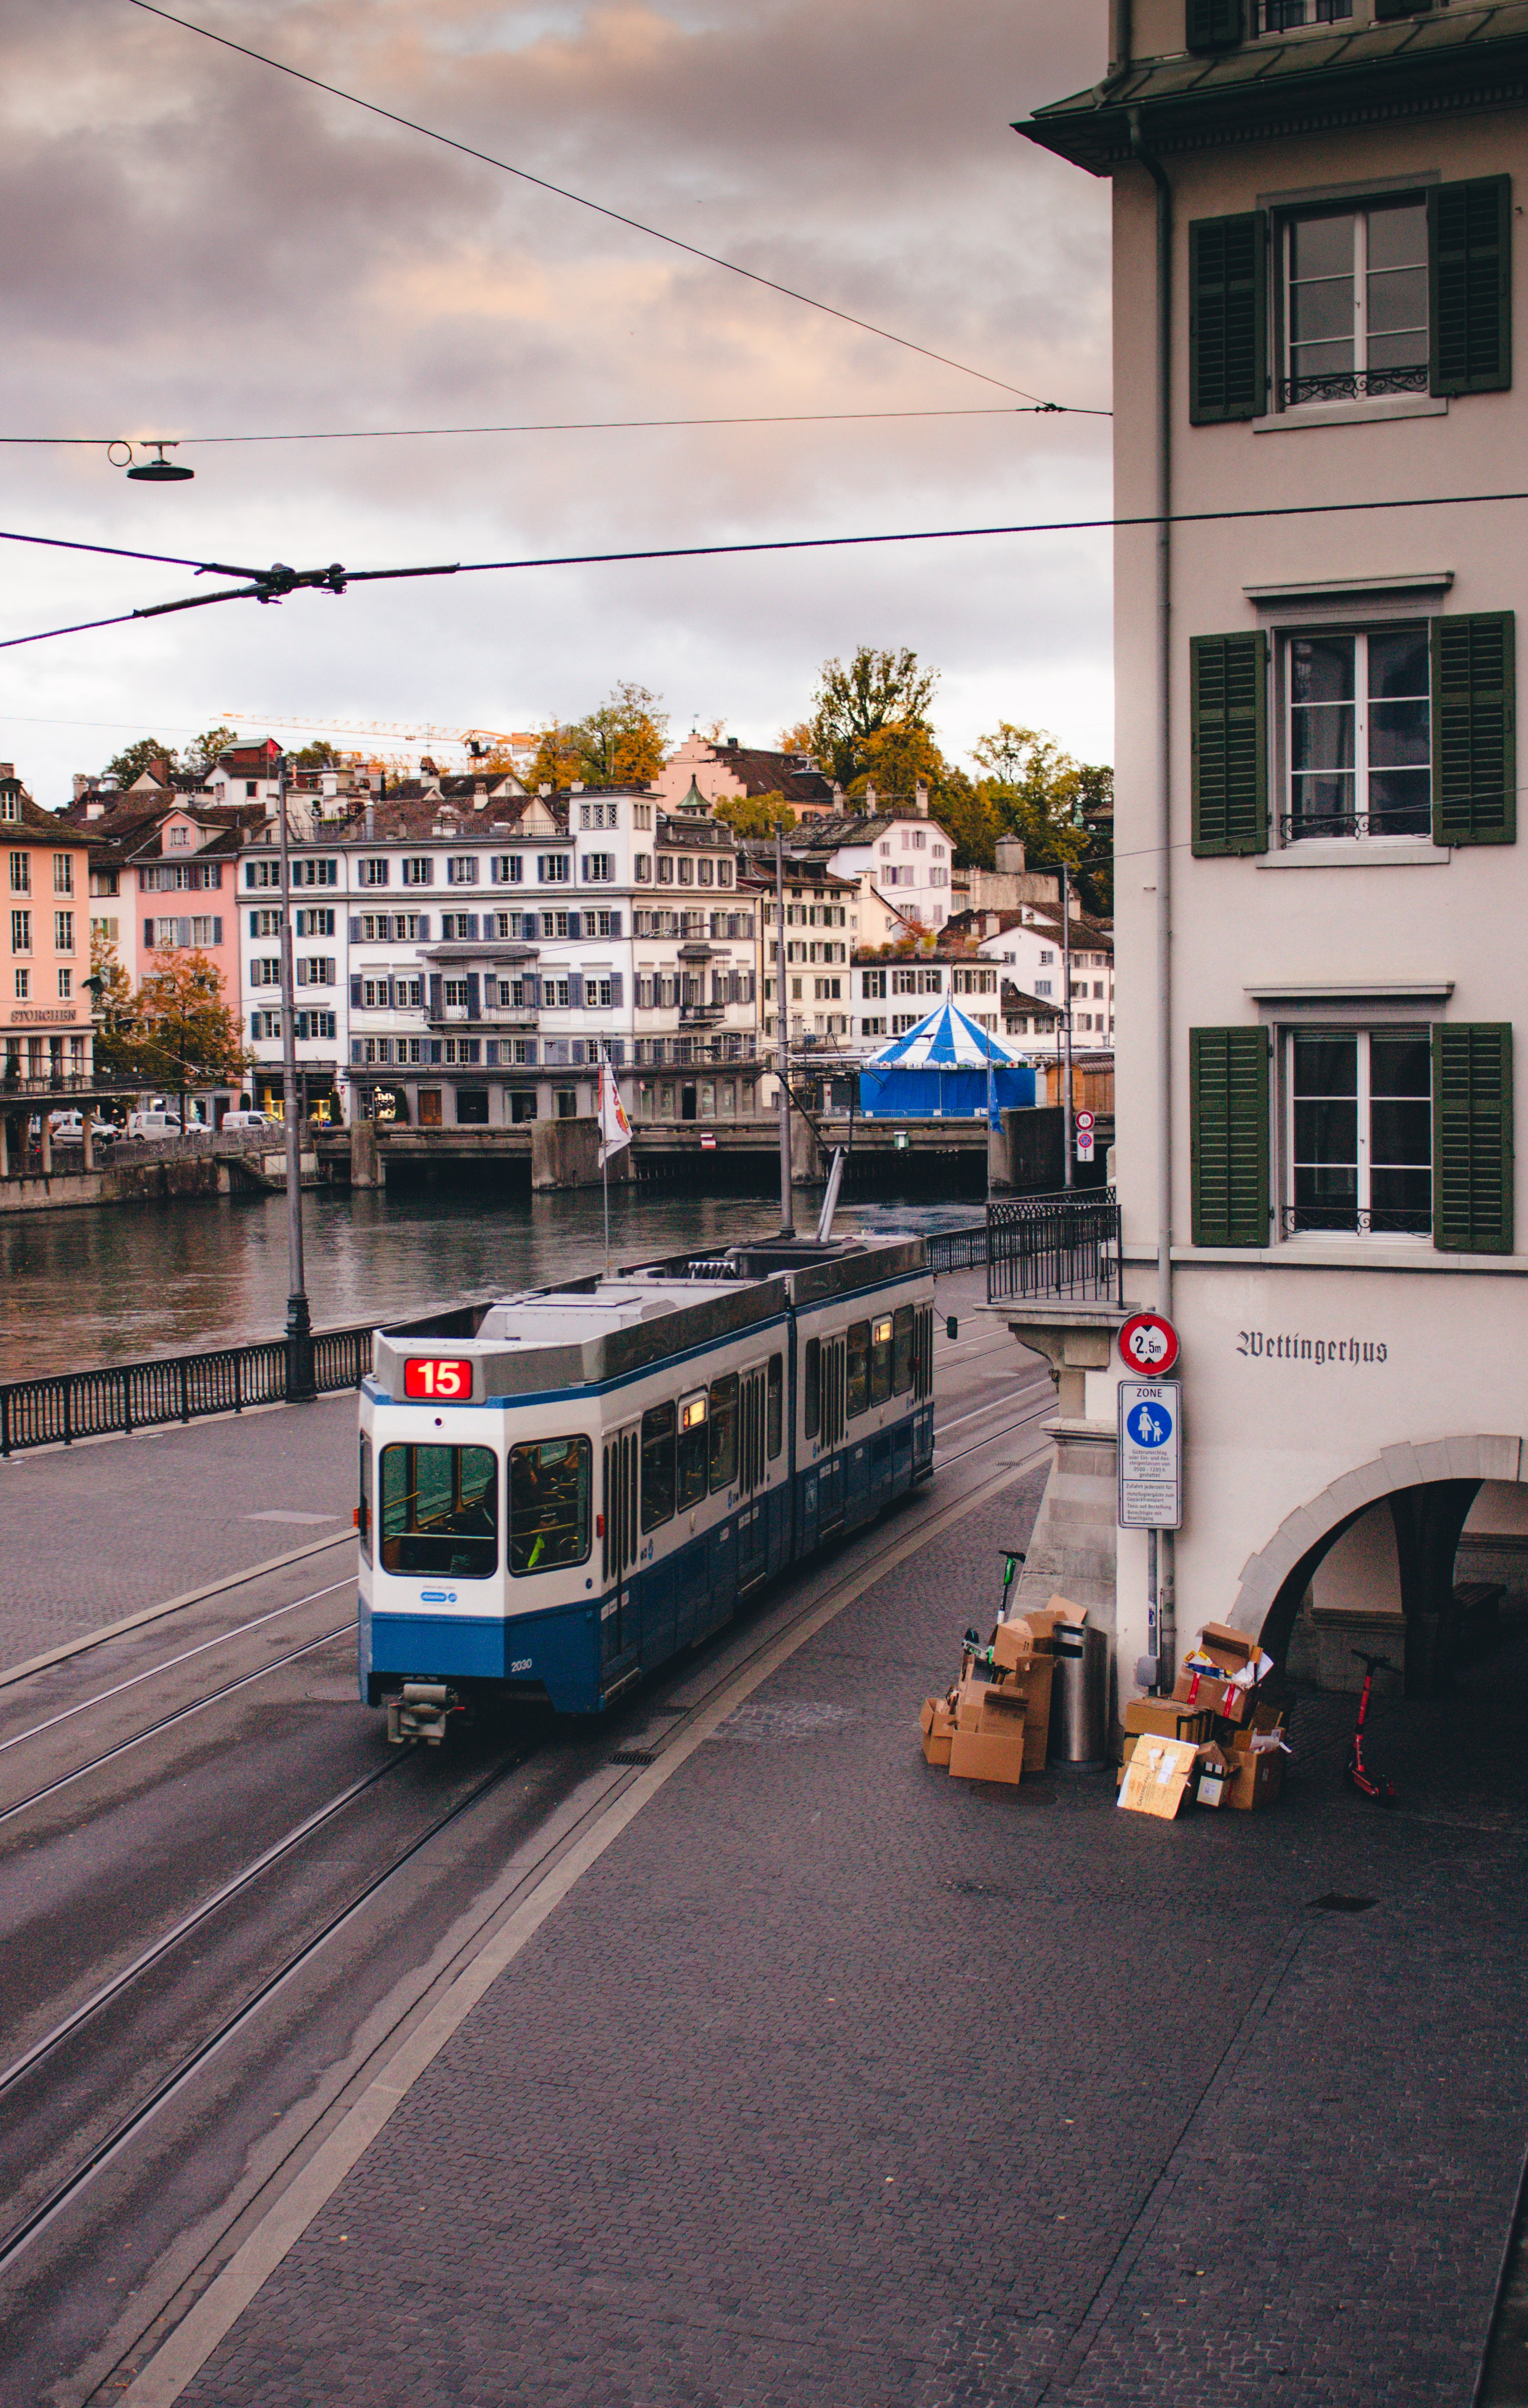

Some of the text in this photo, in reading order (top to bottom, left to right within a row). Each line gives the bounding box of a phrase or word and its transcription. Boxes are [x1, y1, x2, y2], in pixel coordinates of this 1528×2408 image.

[11, 1009, 76, 1022] STORCHEN
[1236, 1330, 1387, 1367] Wettingerhus
[417, 1361, 461, 1395] 15
[1137, 1388, 1163, 1397] ZONE
[511, 1658, 532, 1672] 2030
